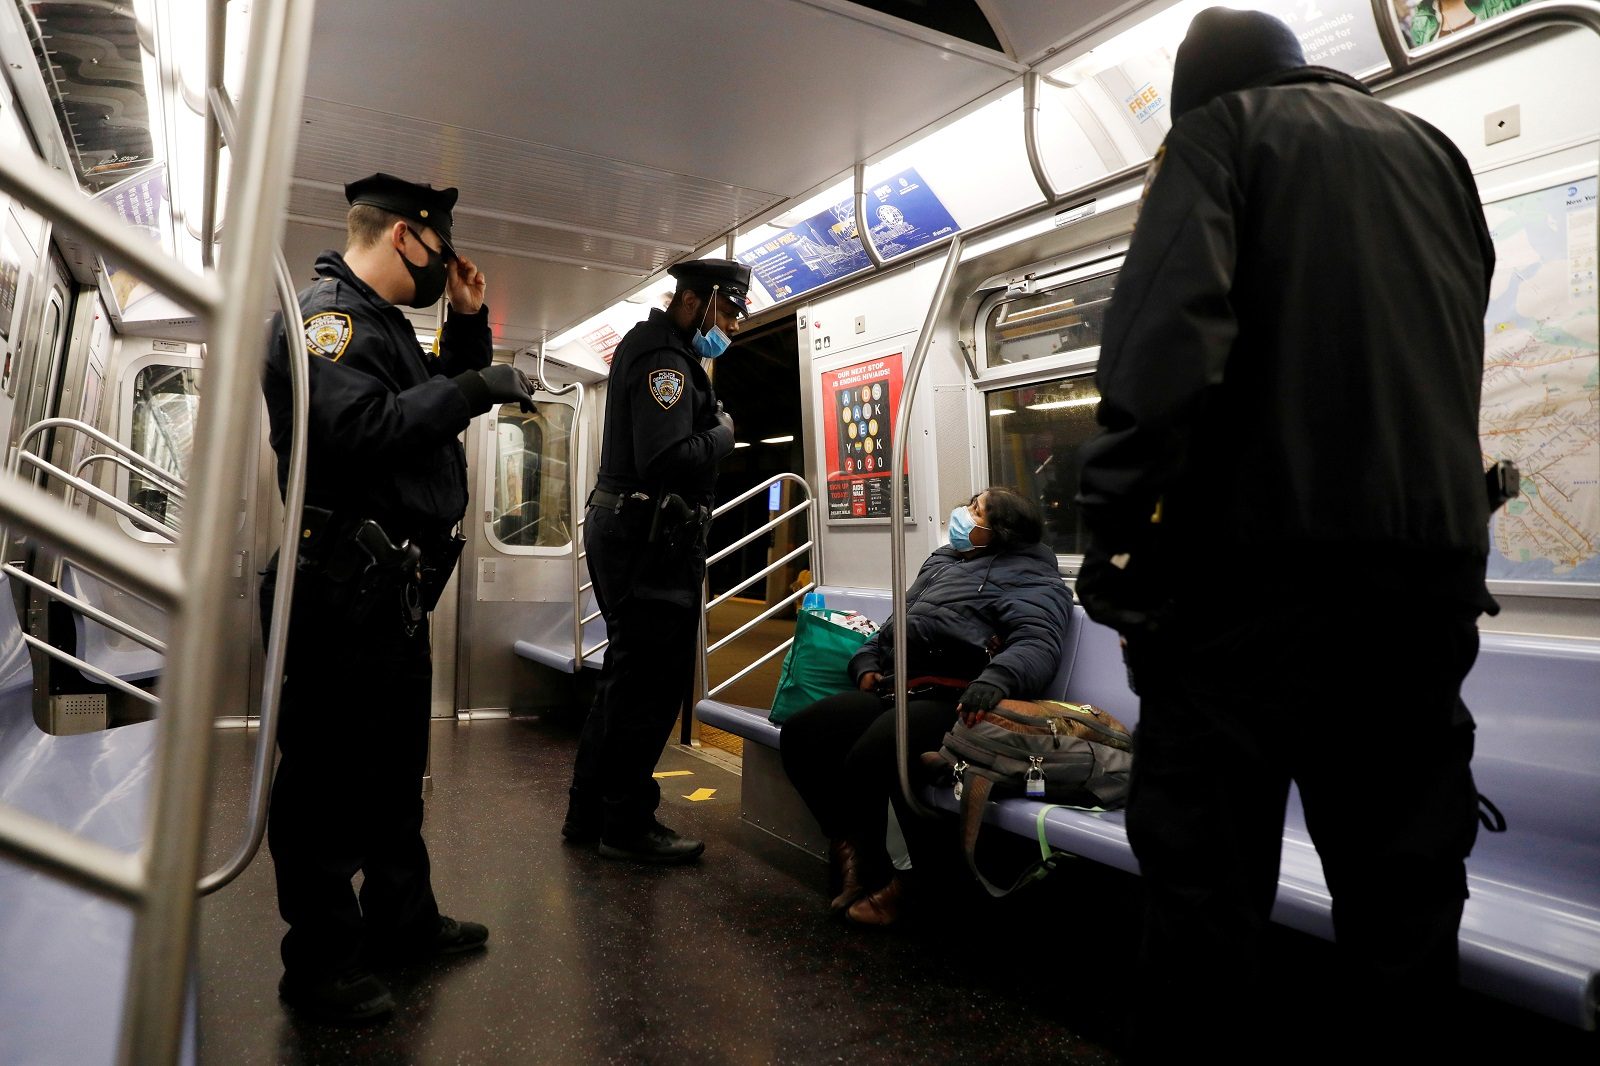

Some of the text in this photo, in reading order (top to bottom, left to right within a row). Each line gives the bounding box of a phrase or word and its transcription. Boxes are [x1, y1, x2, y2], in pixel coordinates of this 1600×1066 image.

[1301, 28, 1351, 53] ligible for
[1310, 41, 1357, 61] tax prep.
[1128, 86, 1158, 113] FREE
[1147, 97, 1163, 112] PREP
[838, 362, 884, 379] OUR NEXT STOP
[840, 375, 861, 386] ENDING
[847, 457, 883, 471] 2020
